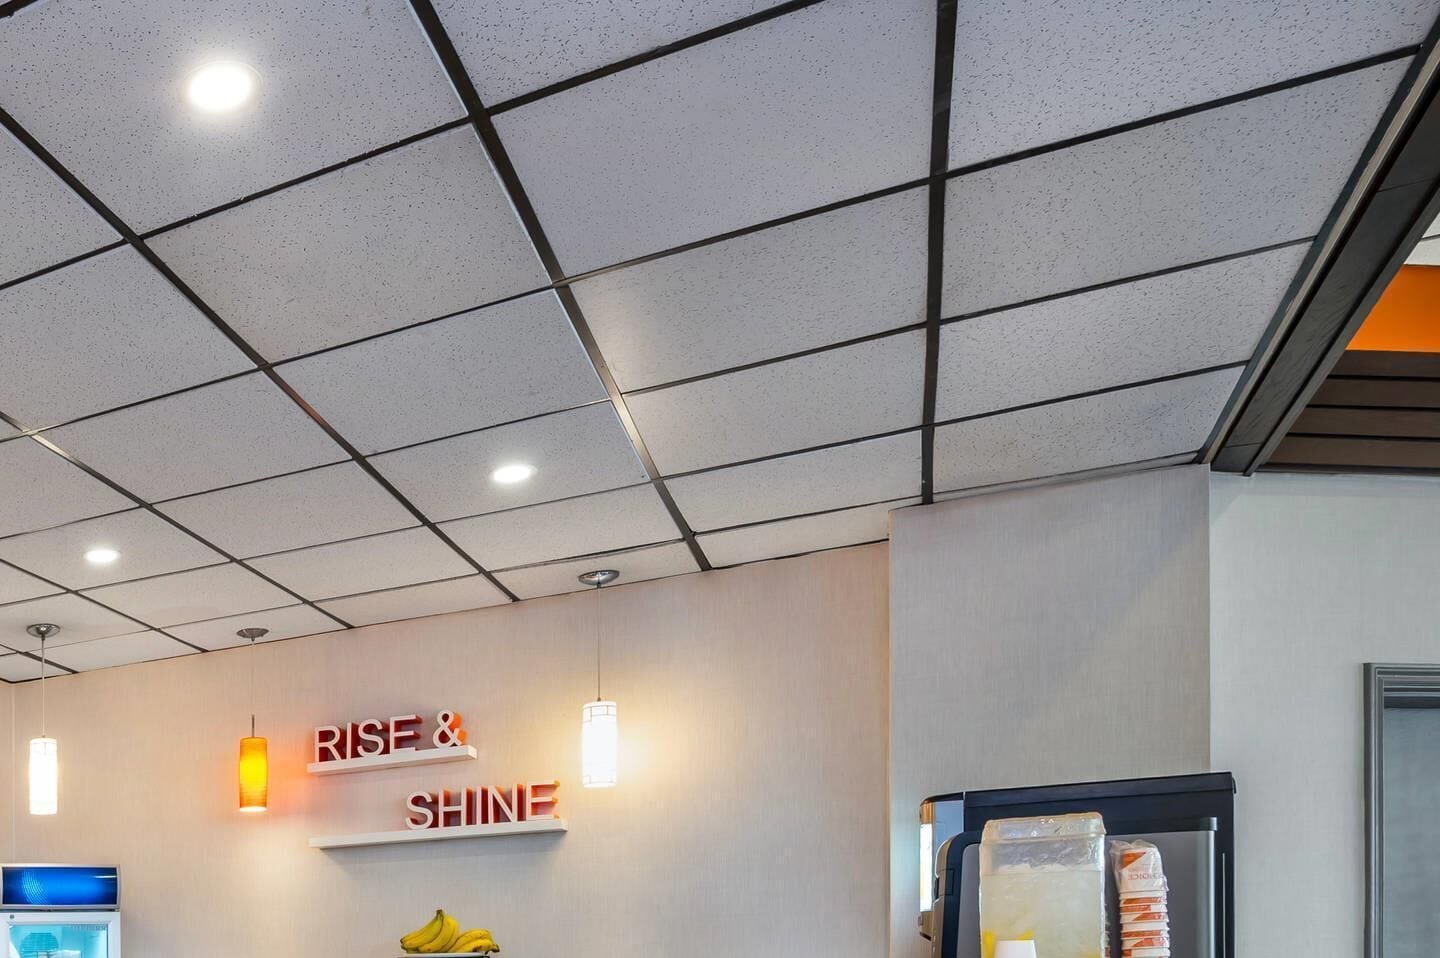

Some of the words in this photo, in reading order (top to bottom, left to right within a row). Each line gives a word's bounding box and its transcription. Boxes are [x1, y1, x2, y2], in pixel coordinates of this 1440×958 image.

[314, 713, 421, 763] RISE
[432, 709, 465, 748] &
[405, 780, 559, 829] SHINE
